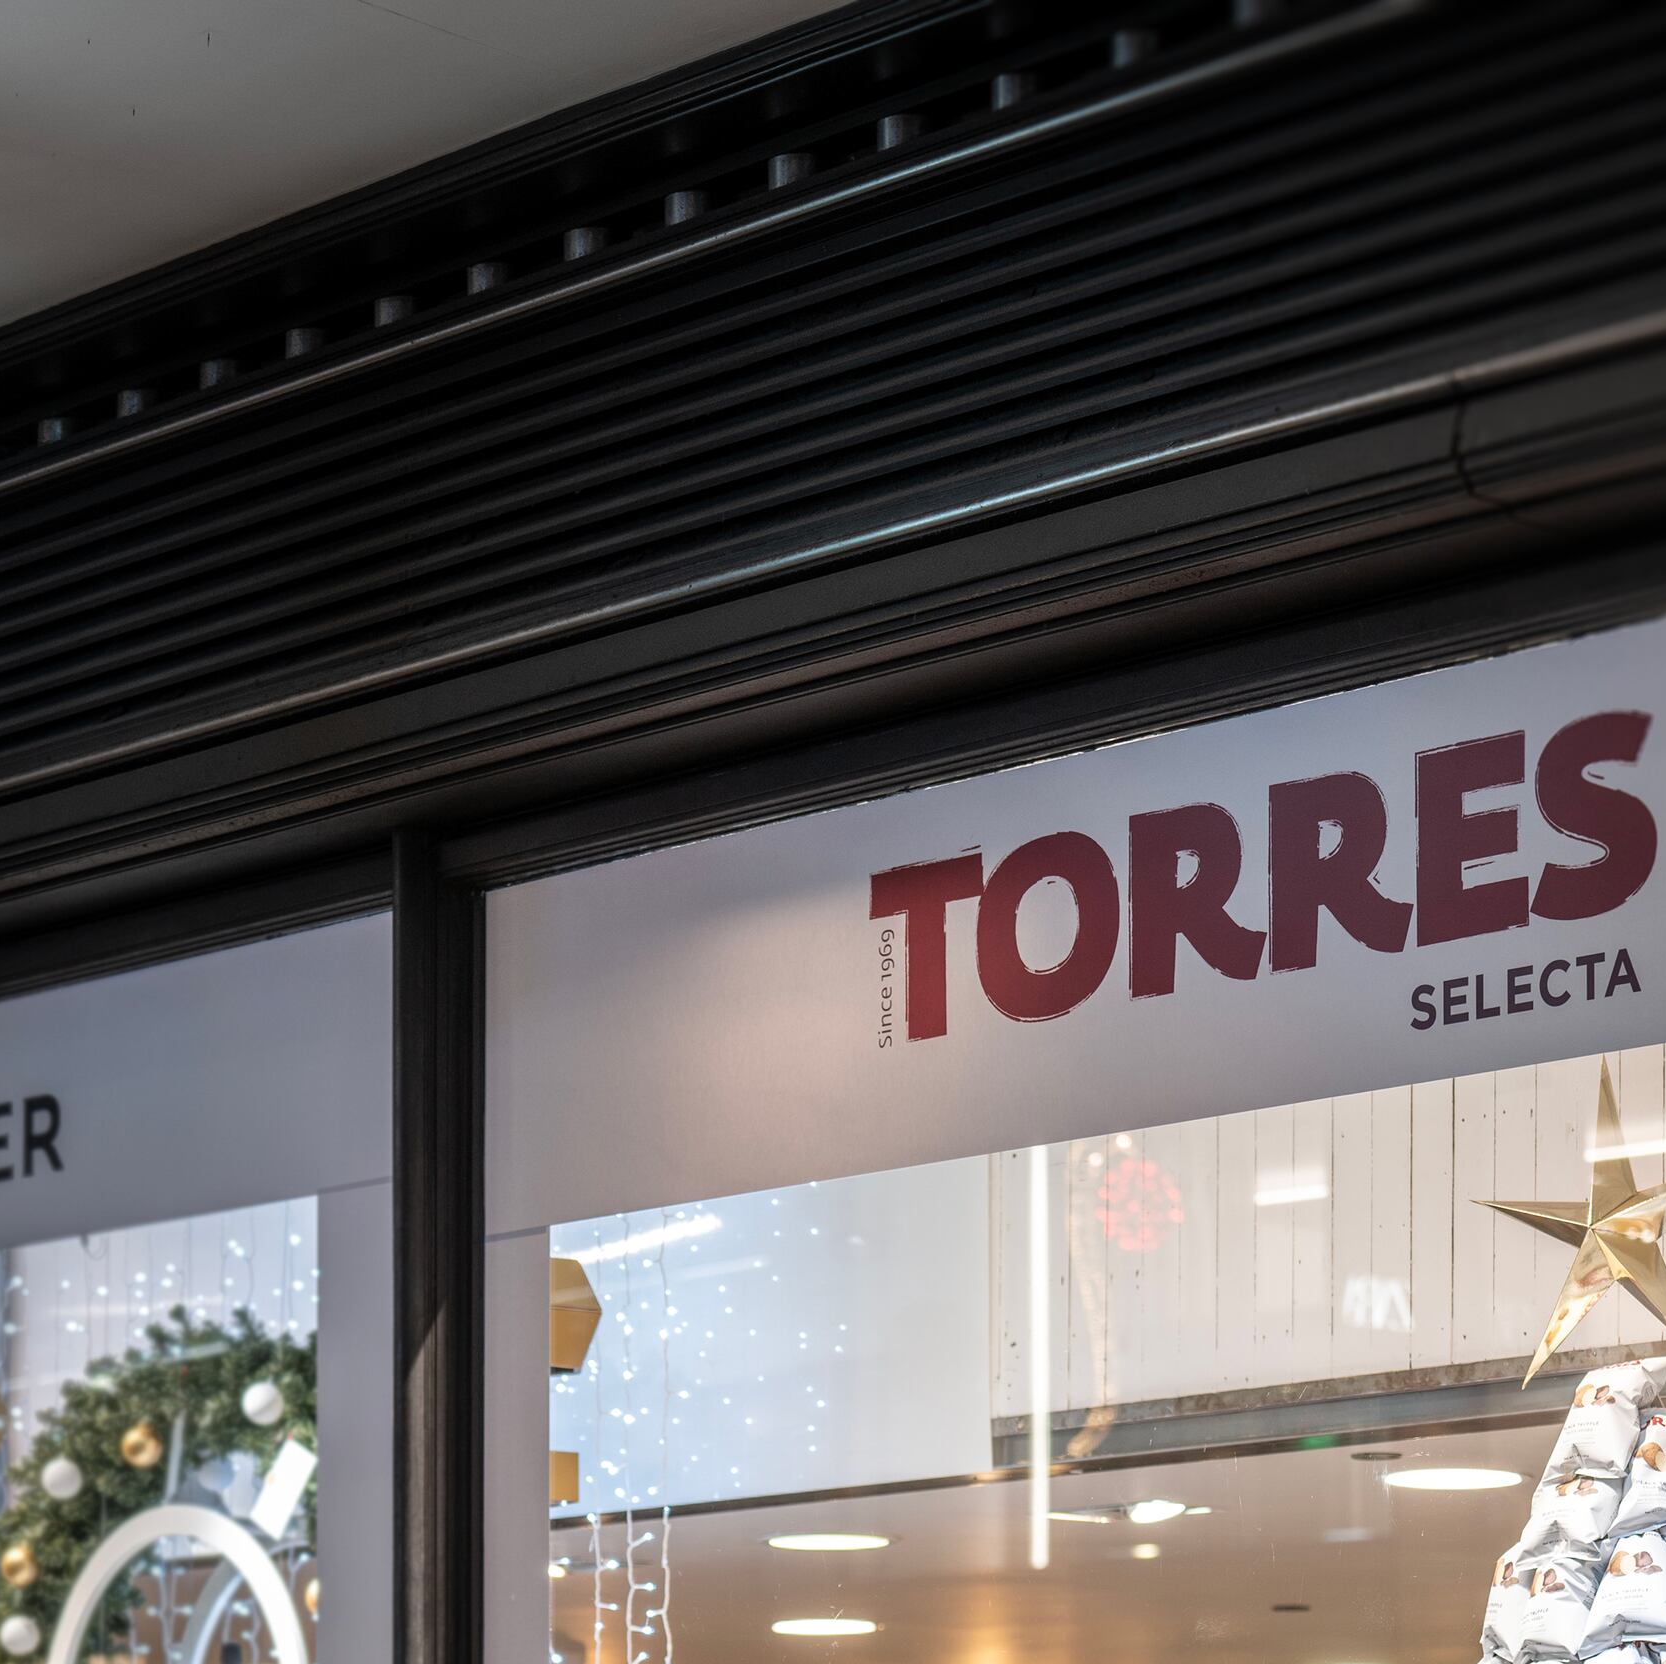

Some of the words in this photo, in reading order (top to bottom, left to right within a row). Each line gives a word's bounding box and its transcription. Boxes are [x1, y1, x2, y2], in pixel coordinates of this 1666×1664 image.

[870, 709, 1659, 1042] TORRES
[878, 928, 895, 982] 1969
[1410, 948, 1642, 1031] SELECTA
[878, 985, 893, 1049] Since
